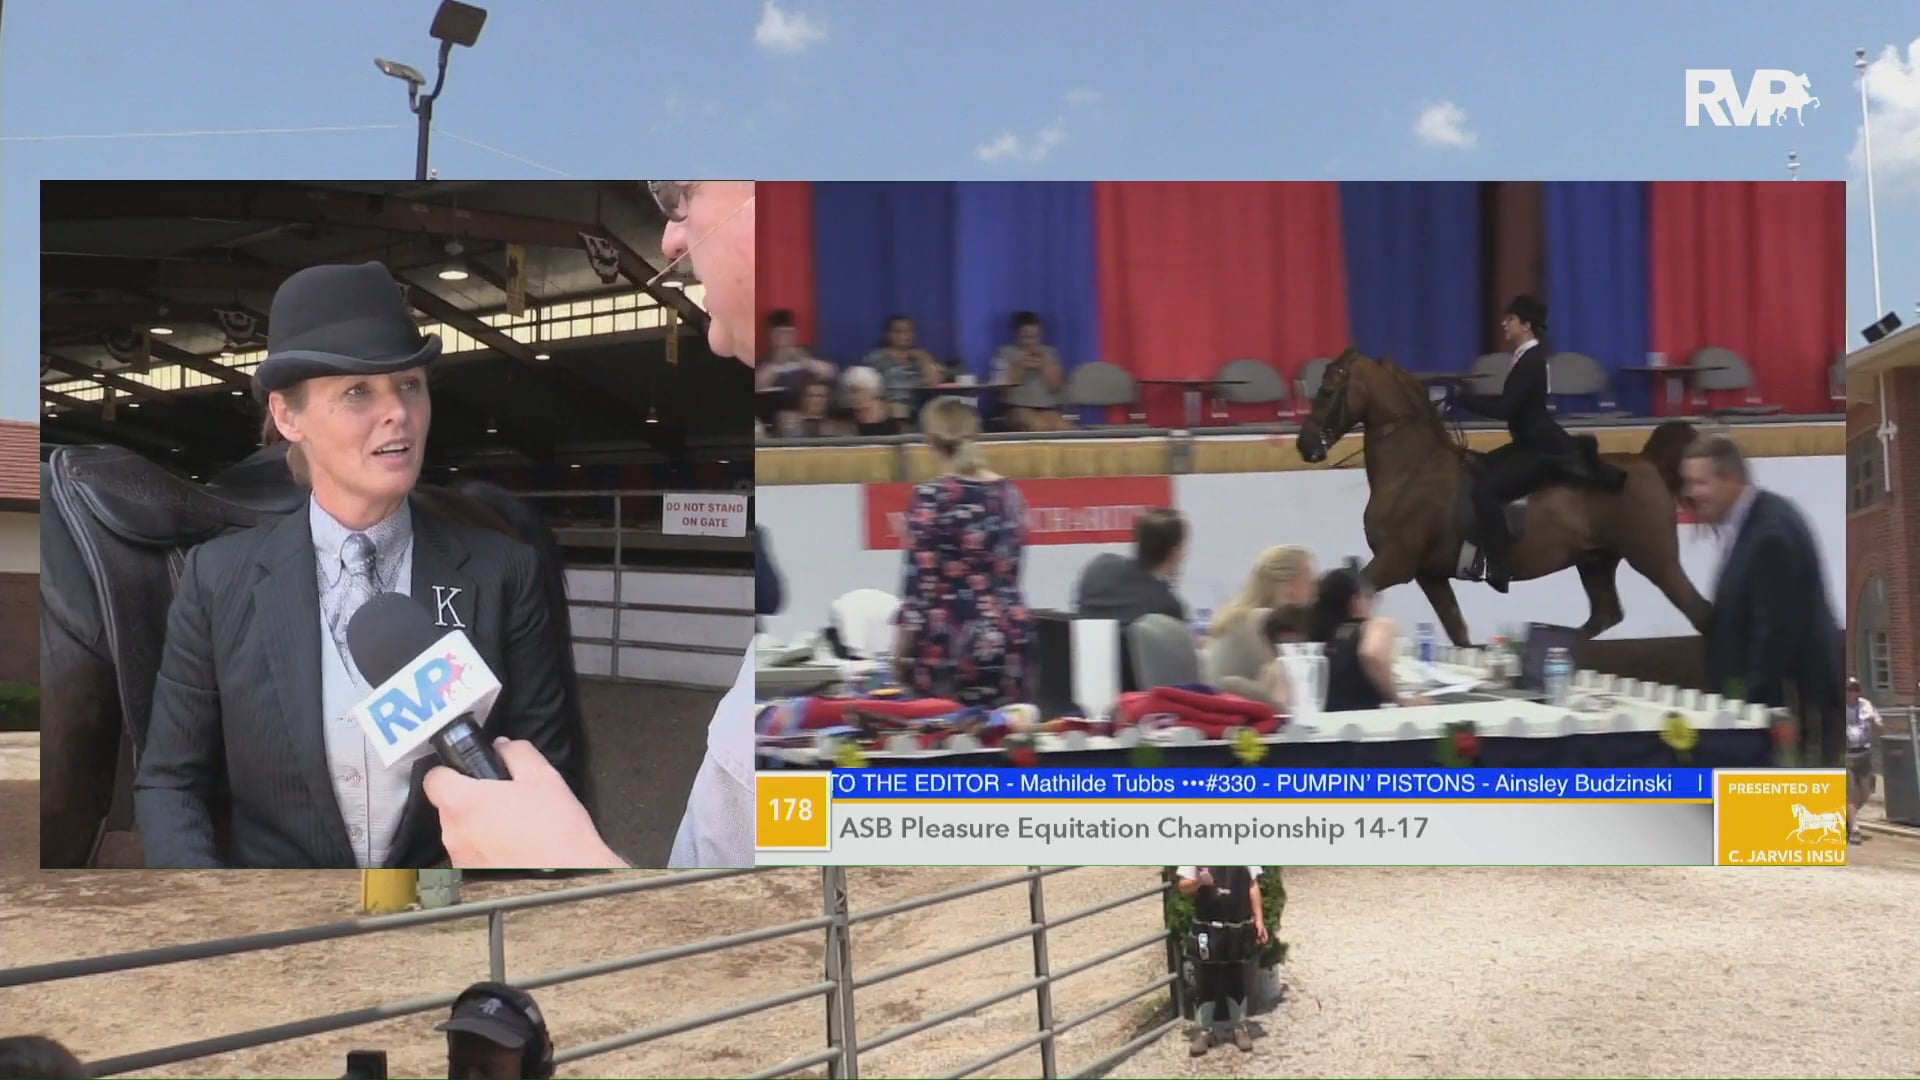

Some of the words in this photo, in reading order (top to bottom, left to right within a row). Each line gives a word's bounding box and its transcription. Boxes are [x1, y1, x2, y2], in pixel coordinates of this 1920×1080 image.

[665, 502, 681, 512] DO
[683, 502, 705, 513] NOT
[707, 503, 744, 514] STAND
[682, 517, 698, 527] ON
[700, 518, 729, 528] GATE
[431, 585, 466, 628] K
[367, 655, 455, 746] RVP
